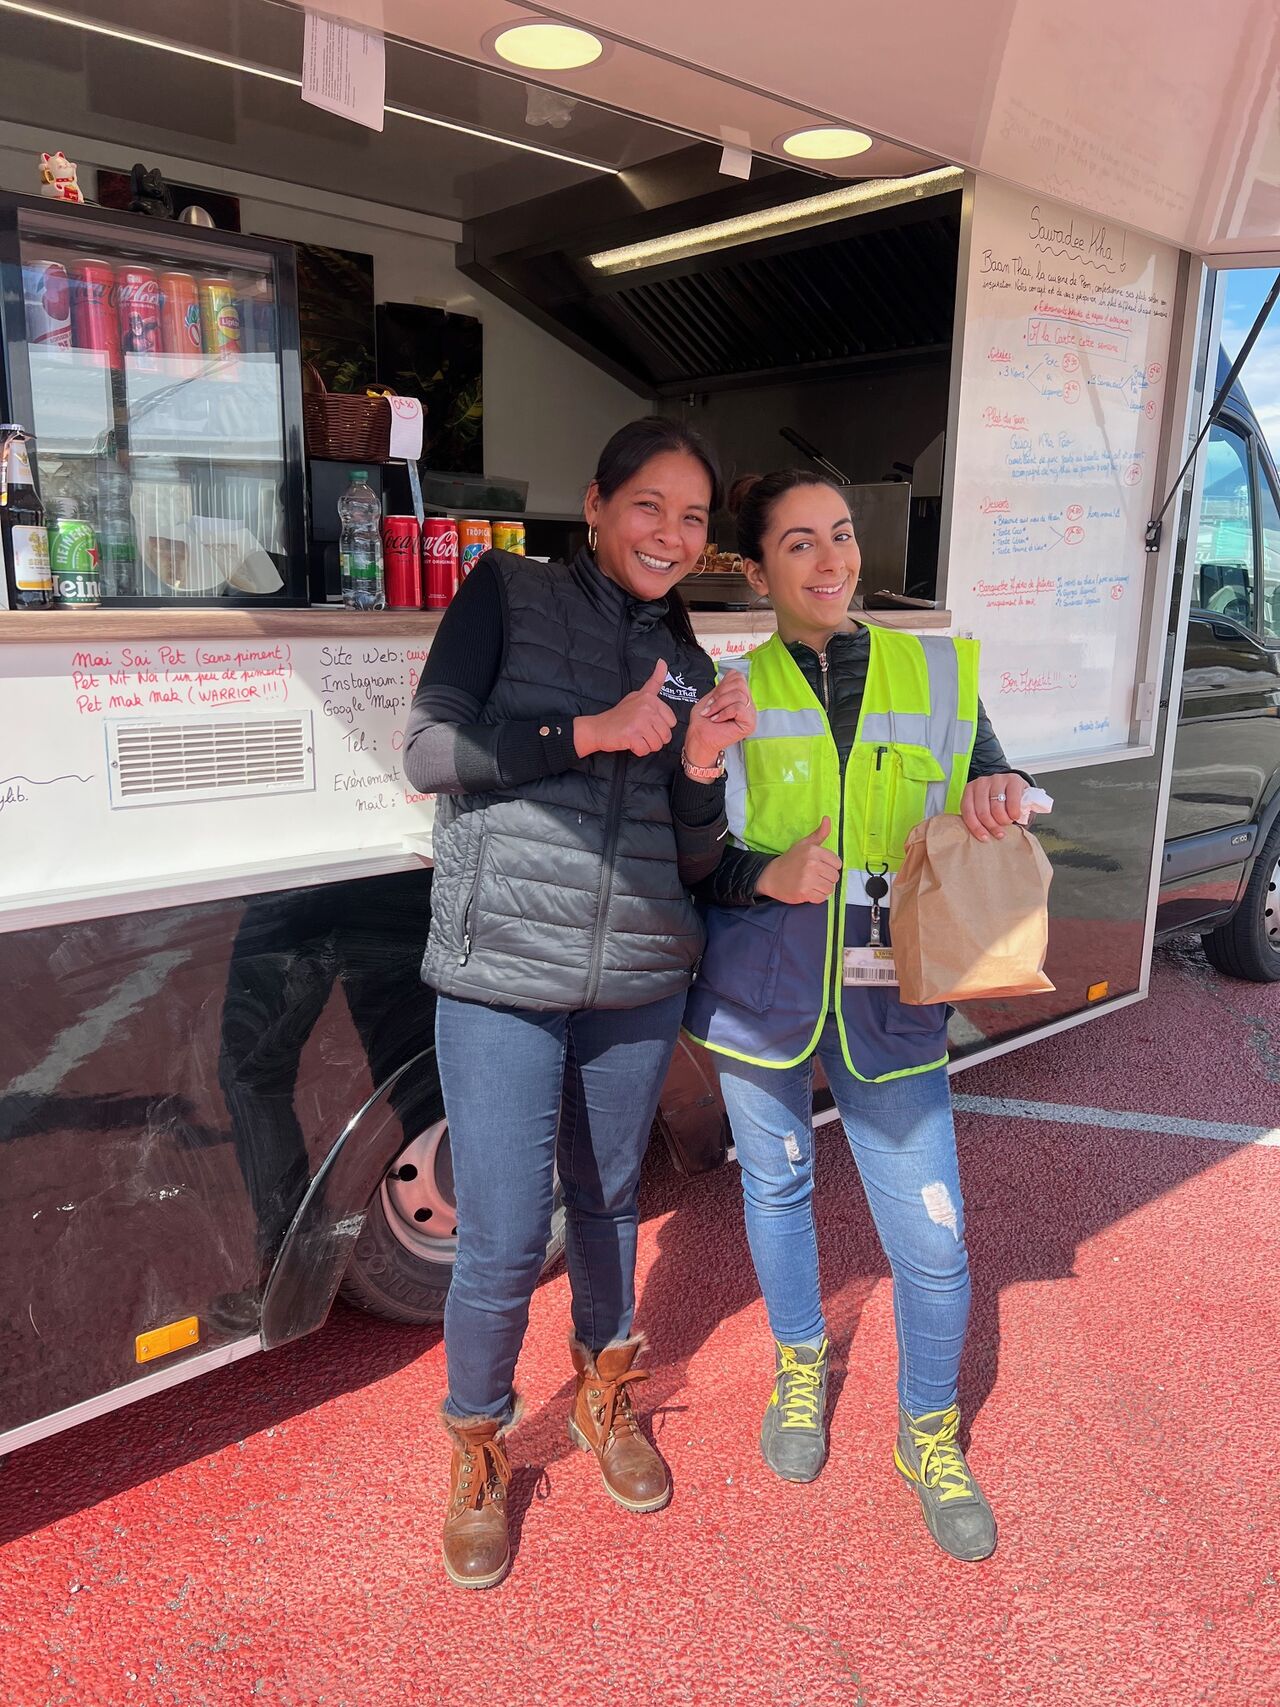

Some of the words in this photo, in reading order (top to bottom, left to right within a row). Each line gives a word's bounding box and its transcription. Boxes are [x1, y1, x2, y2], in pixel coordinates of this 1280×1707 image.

[1028, 206, 1085, 251] Sawadee
[1089, 226, 1113, 260] Kha
[980, 249, 1010, 273] Baan
[72, 650, 112, 668] Mai
[121, 648, 152, 667] Sai
[158, 645, 187, 665] Pet
[319, 645, 352, 666] Site
[726, 640, 746, 653] lundi
[72, 670, 100, 690] Pet
[195, 671, 219, 687] peu
[222, 668, 238, 680] de
[659, 685, 676, 695] aan
[76, 694, 102, 714] Pet
[323, 698, 366, 724] Google
